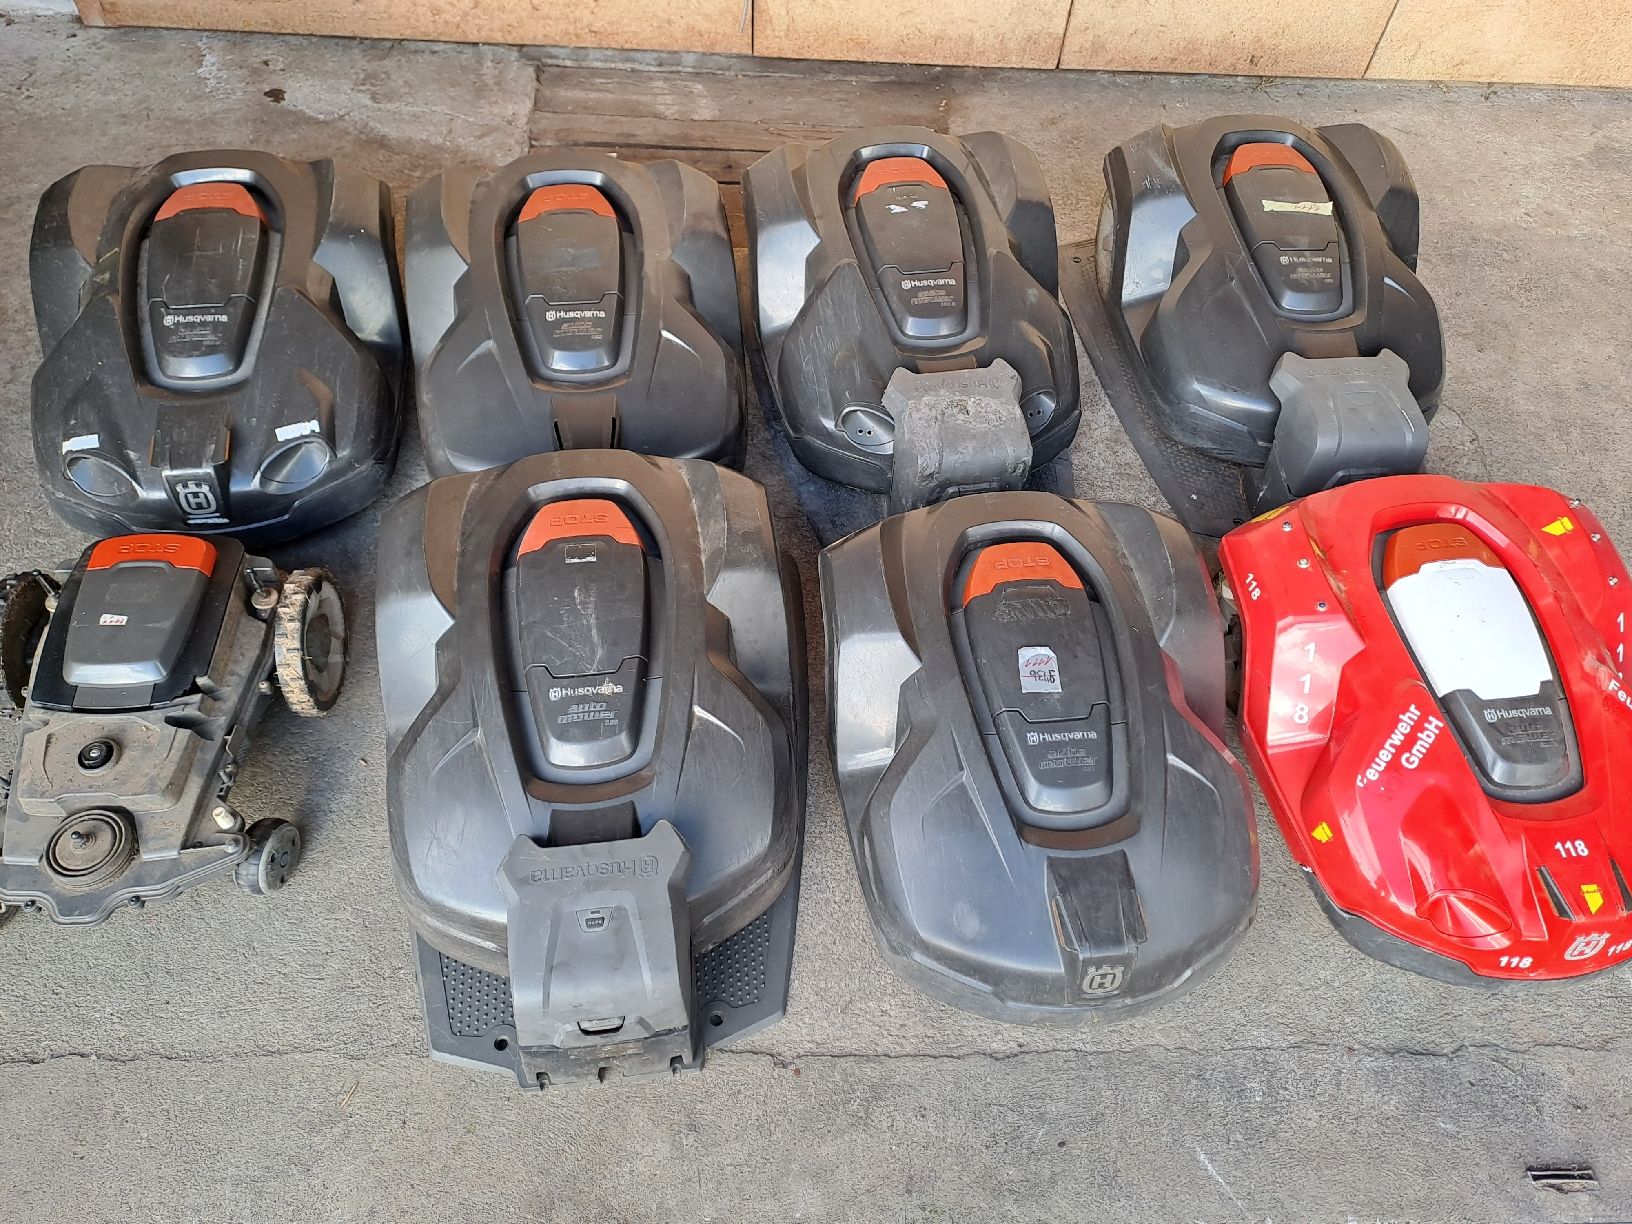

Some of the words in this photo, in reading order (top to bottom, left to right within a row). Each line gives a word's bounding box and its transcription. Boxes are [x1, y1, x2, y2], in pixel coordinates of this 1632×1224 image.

[911, 278, 957, 288] Husqvarna
[175, 314, 228, 323] Husqvarna
[556, 310, 606, 320] Husqvarna
[550, 512, 608, 527] STOP
[119, 543, 181, 554] STOP
[1415, 537, 1468, 551] STOP
[994, 556, 1050, 570] STOP
[1245, 573, 1261, 601] 118
[562, 683, 623, 697] Husqvarna
[1497, 707, 1552, 719] Husqvarna
[1039, 730, 1097, 743] Husqvarna
[1400, 715, 1444, 770] GmbH
[1554, 839, 1589, 858] 118
[529, 859, 636, 883] Husqvarna
[1498, 955, 1534, 969] 118
